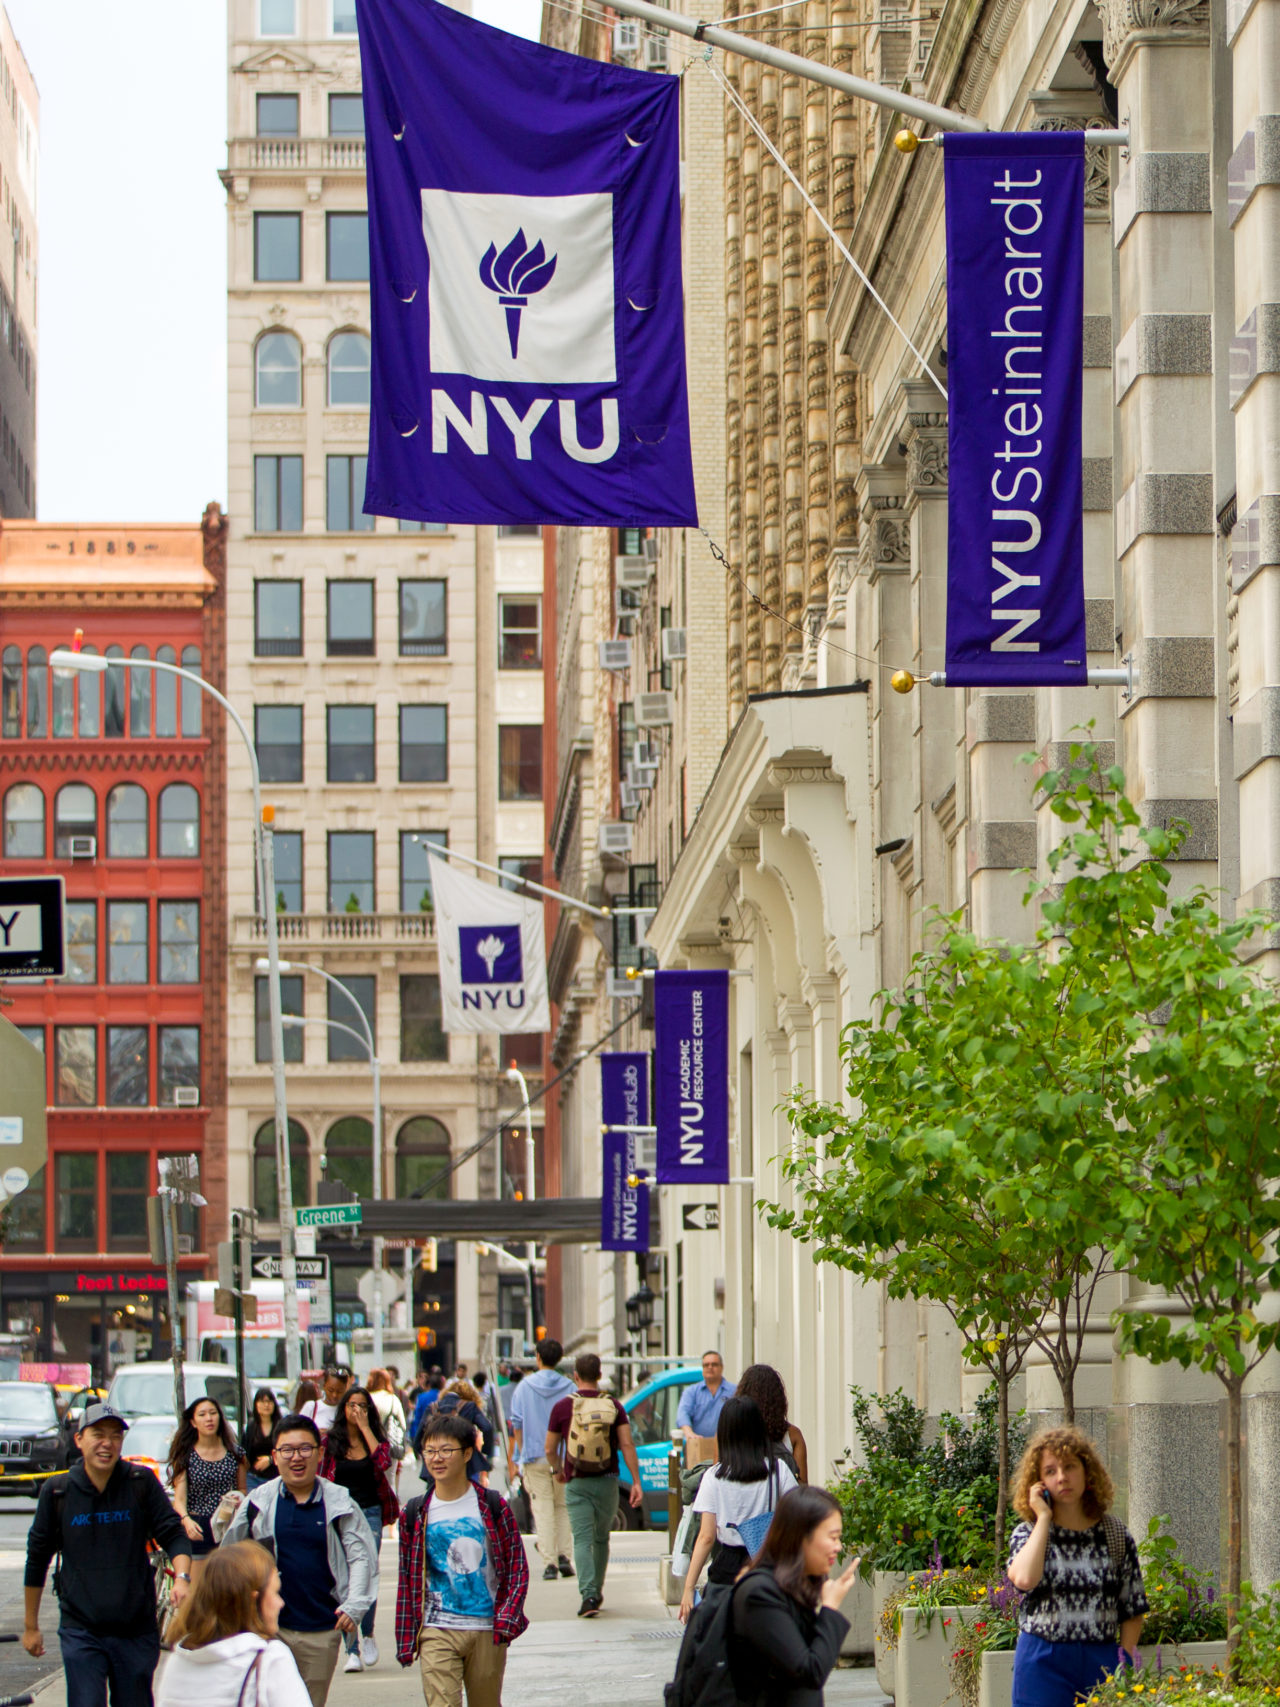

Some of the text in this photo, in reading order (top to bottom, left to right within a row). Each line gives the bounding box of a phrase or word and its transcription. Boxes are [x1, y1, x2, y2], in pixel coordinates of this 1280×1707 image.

[431, 388, 620, 465] NYU
[990, 169, 1043, 653] NYUSteinhardt
[462, 988, 526, 1010] NYU
[680, 1039, 690, 1099] ACADEMIC
[692, 990, 704, 1100] RESOURCE CENTER
[680, 1102, 704, 1165] NYU
[301, 1209, 346, 1224] Greene
[118, 1274, 168, 1291] Locke
[296, 1262, 318, 1273] WAY
